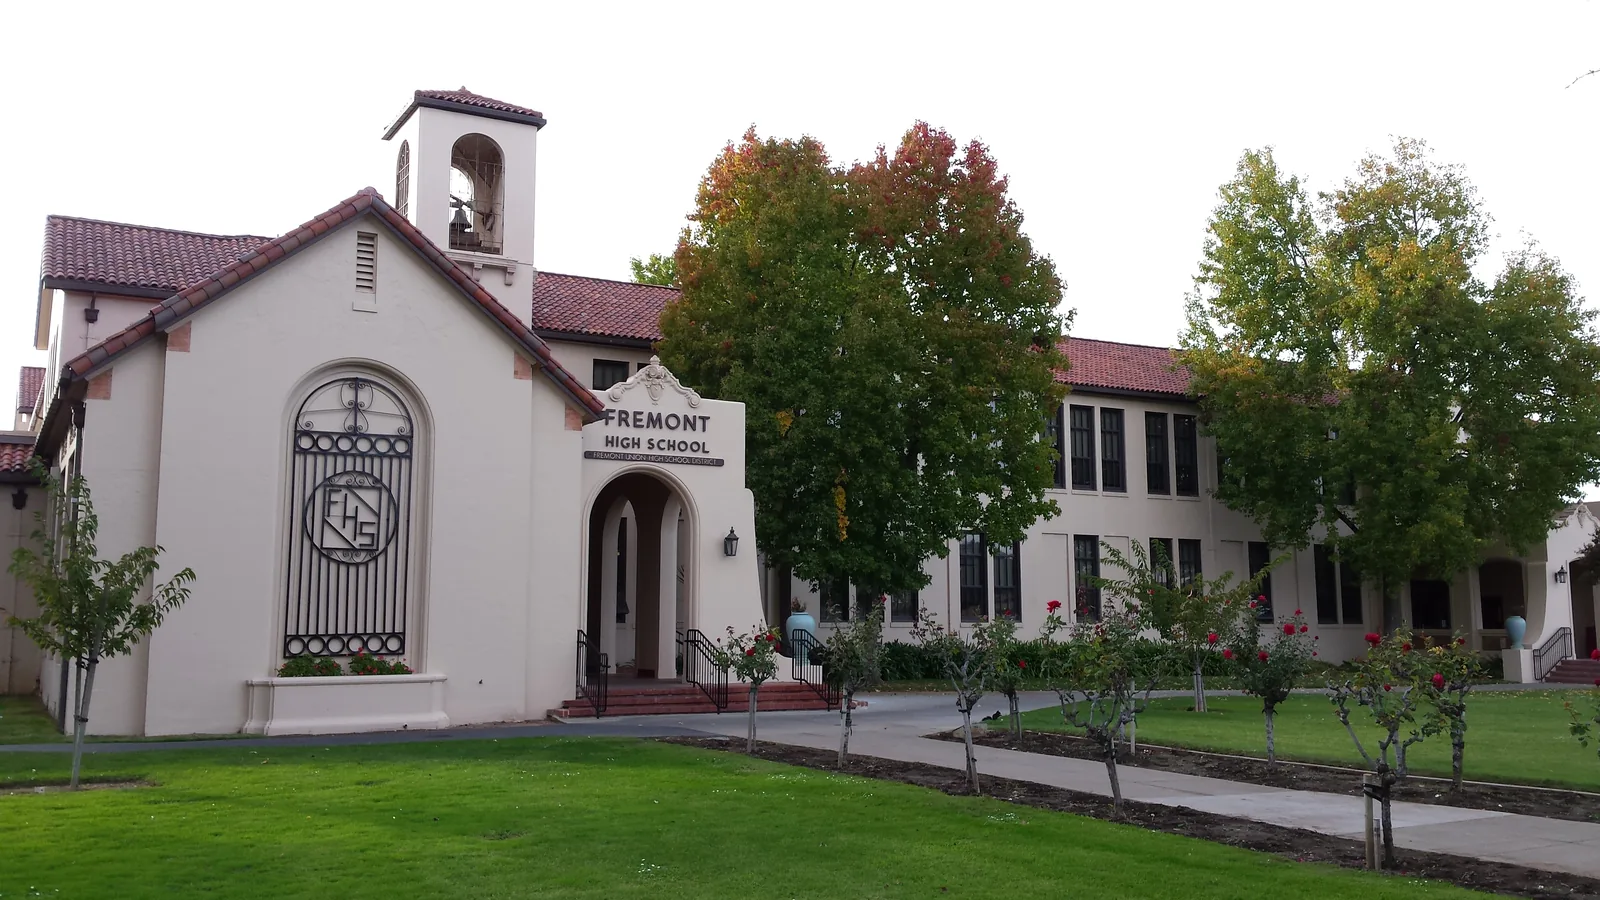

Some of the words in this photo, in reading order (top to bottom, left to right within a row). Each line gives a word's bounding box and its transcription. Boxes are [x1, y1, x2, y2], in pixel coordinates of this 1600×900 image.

[604, 408, 711, 433] FREMONT
[605, 435, 641, 450] HIGH
[647, 438, 710, 454] SCHOOL
[593, 451, 624, 460] FREMONT
[665, 455, 690, 464] SCHOOL
